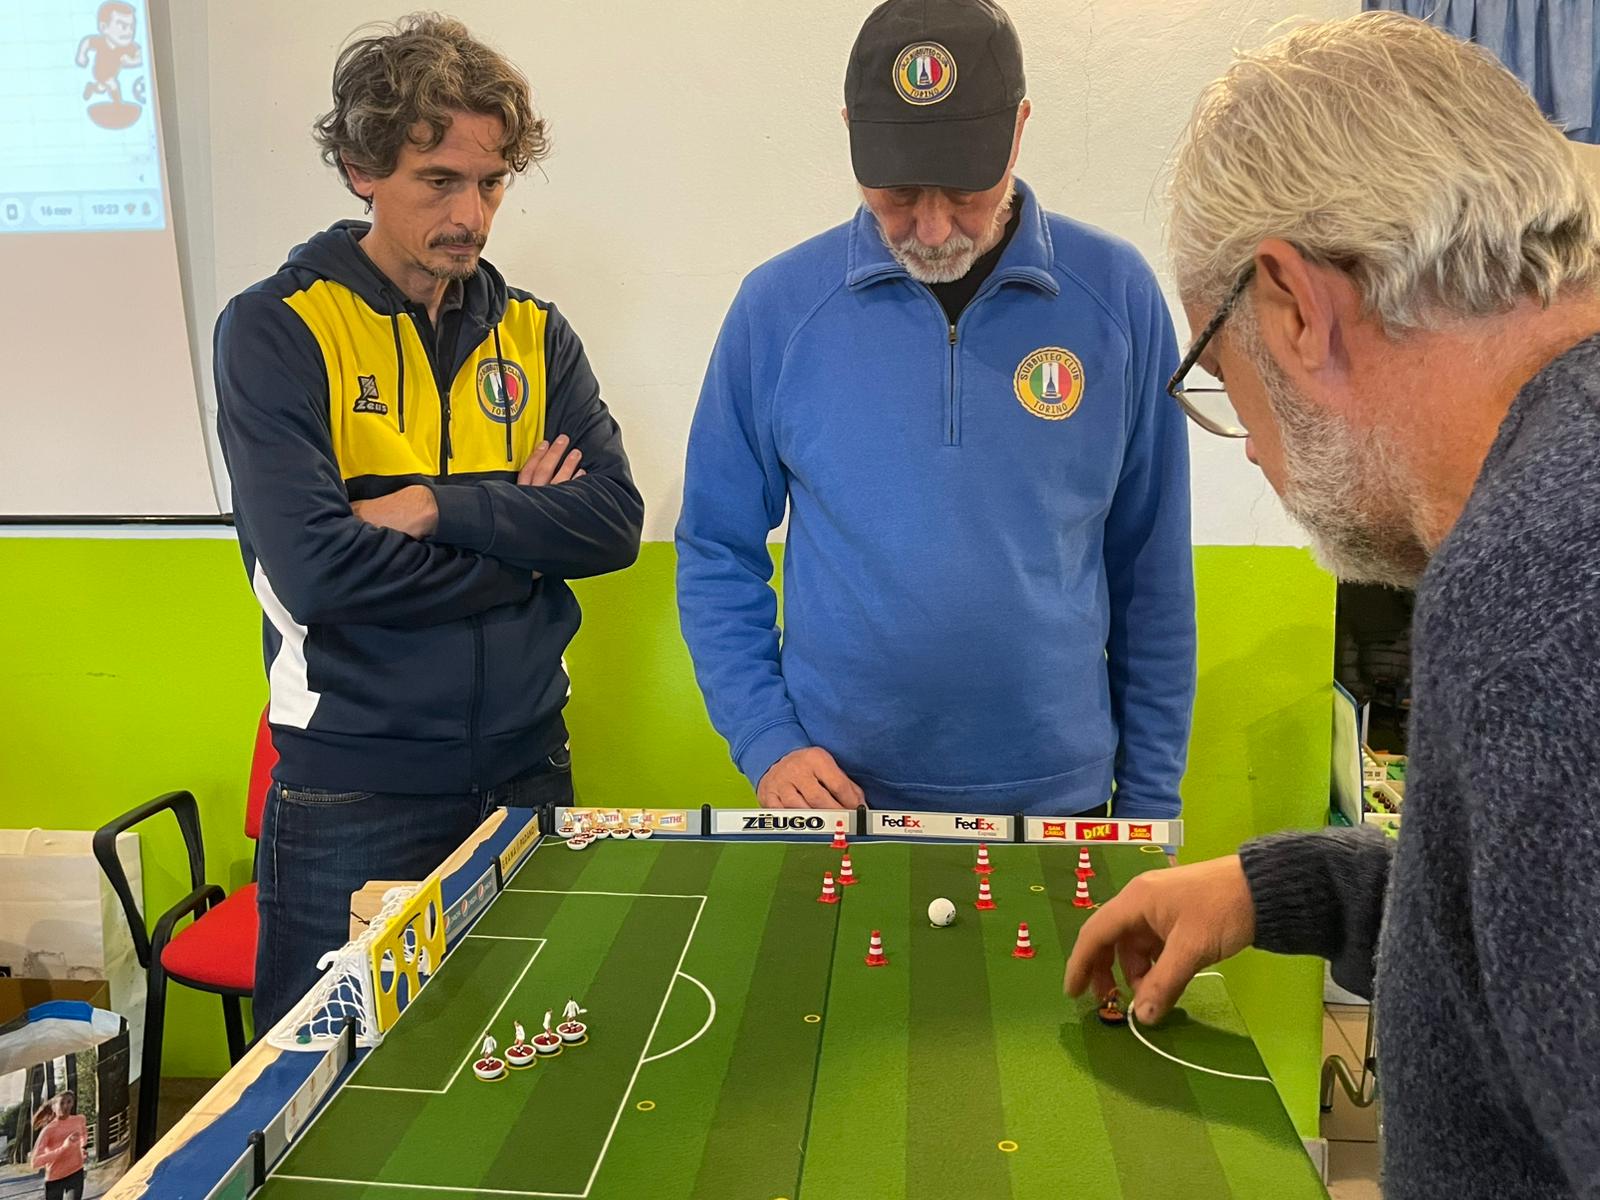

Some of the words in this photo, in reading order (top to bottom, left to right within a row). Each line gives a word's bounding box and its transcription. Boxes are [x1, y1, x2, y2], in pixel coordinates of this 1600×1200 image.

[910, 87, 940, 98] TORINO
[1020, 352, 1062, 381] SUBBUTEO
[1064, 358, 1080, 380] CLUB
[355, 400, 387, 413] Zeus
[1033, 400, 1068, 414] TORINO
[742, 813, 825, 831] ZËUGO
[881, 815, 921, 828] FedEx
[954, 817, 995, 831] FedEx
[1082, 823, 1112, 840] DIXI
